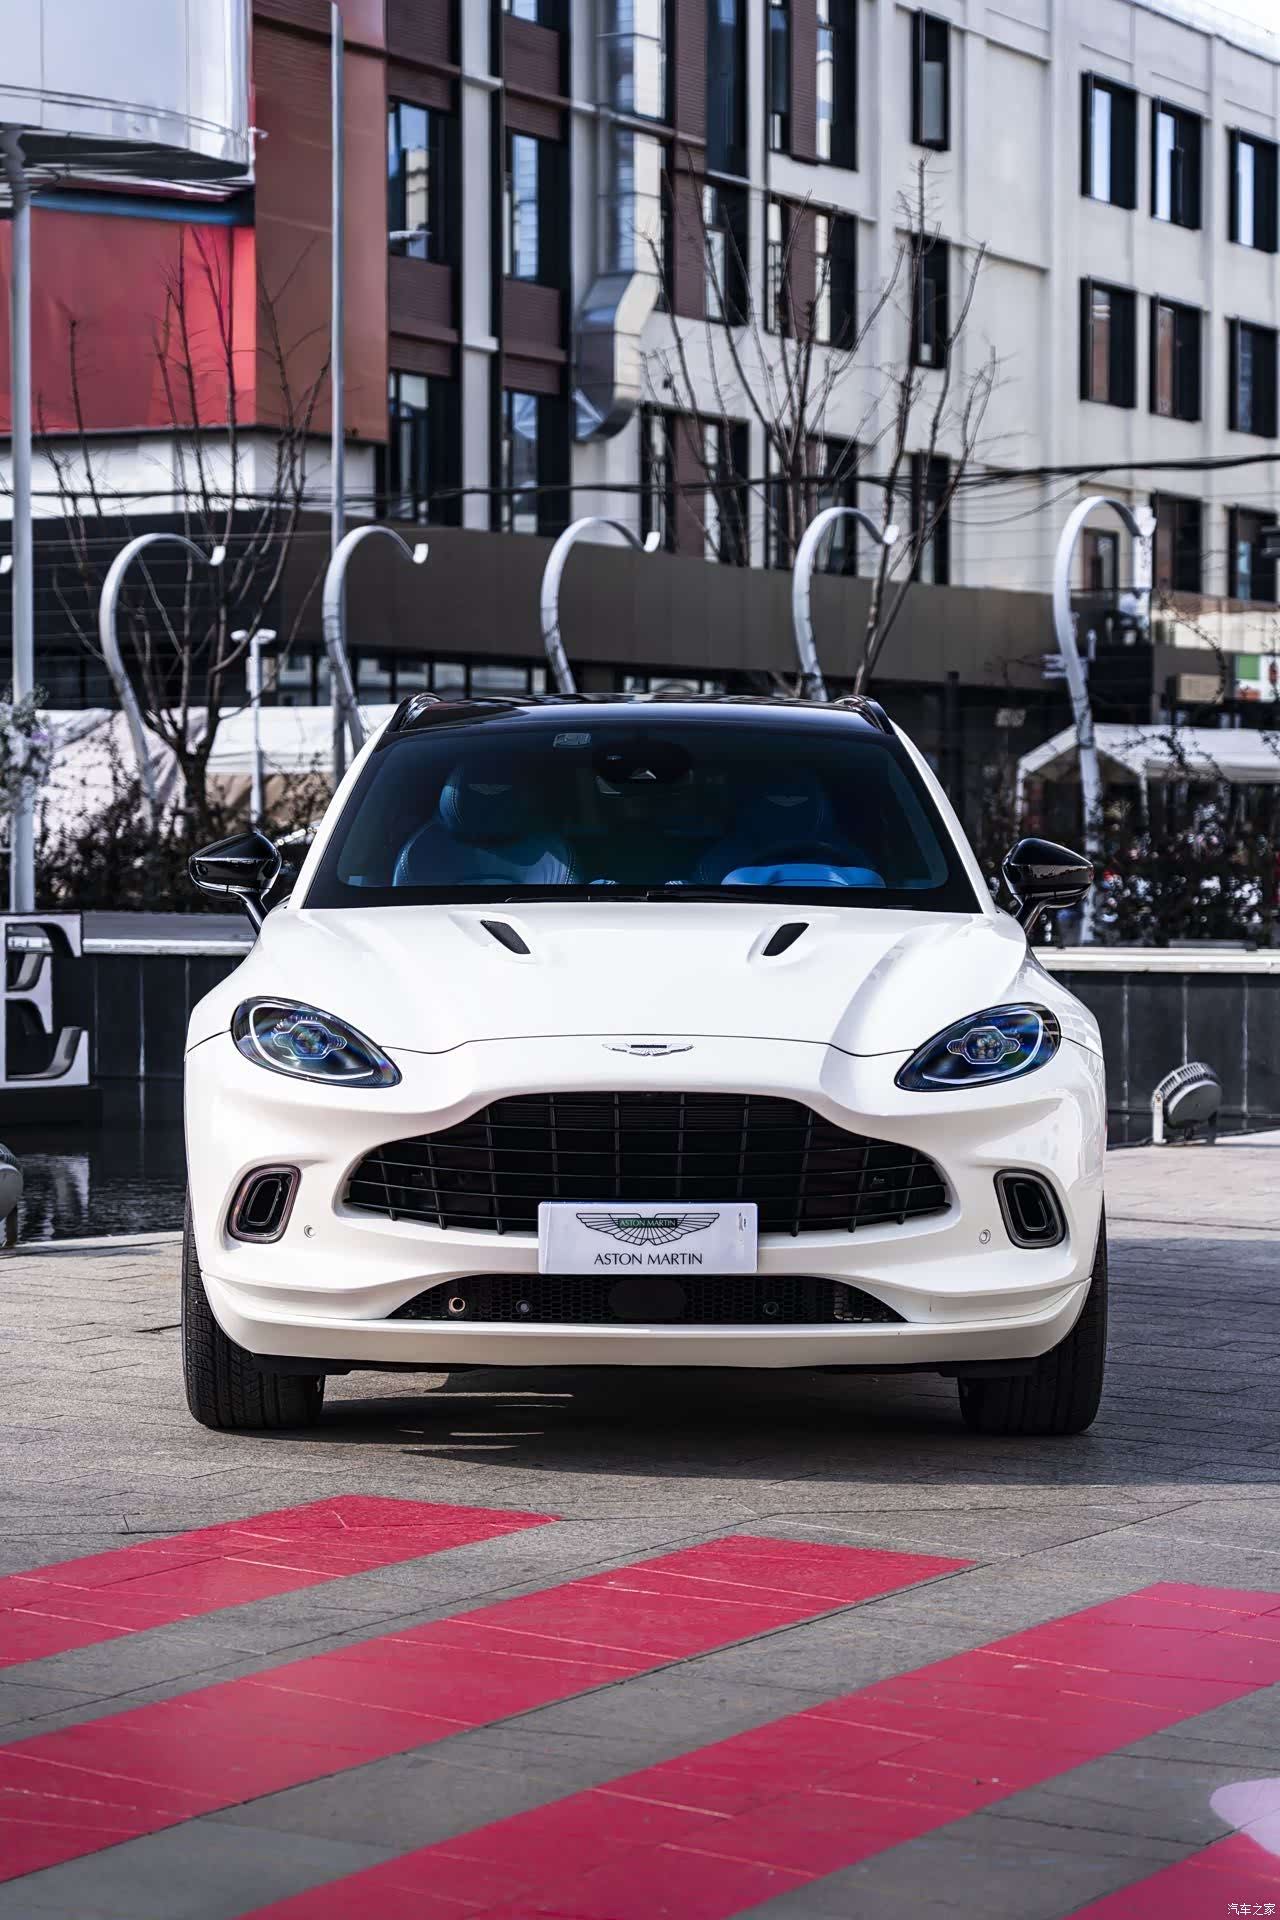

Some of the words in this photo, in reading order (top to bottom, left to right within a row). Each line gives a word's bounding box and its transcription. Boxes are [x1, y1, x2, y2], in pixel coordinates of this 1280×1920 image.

[619, 1219, 645, 1227] ASTON
[646, 1219, 676, 1227] MARTIN
[594, 1253, 642, 1266] ASTON
[647, 1253, 703, 1266] MARTIN
